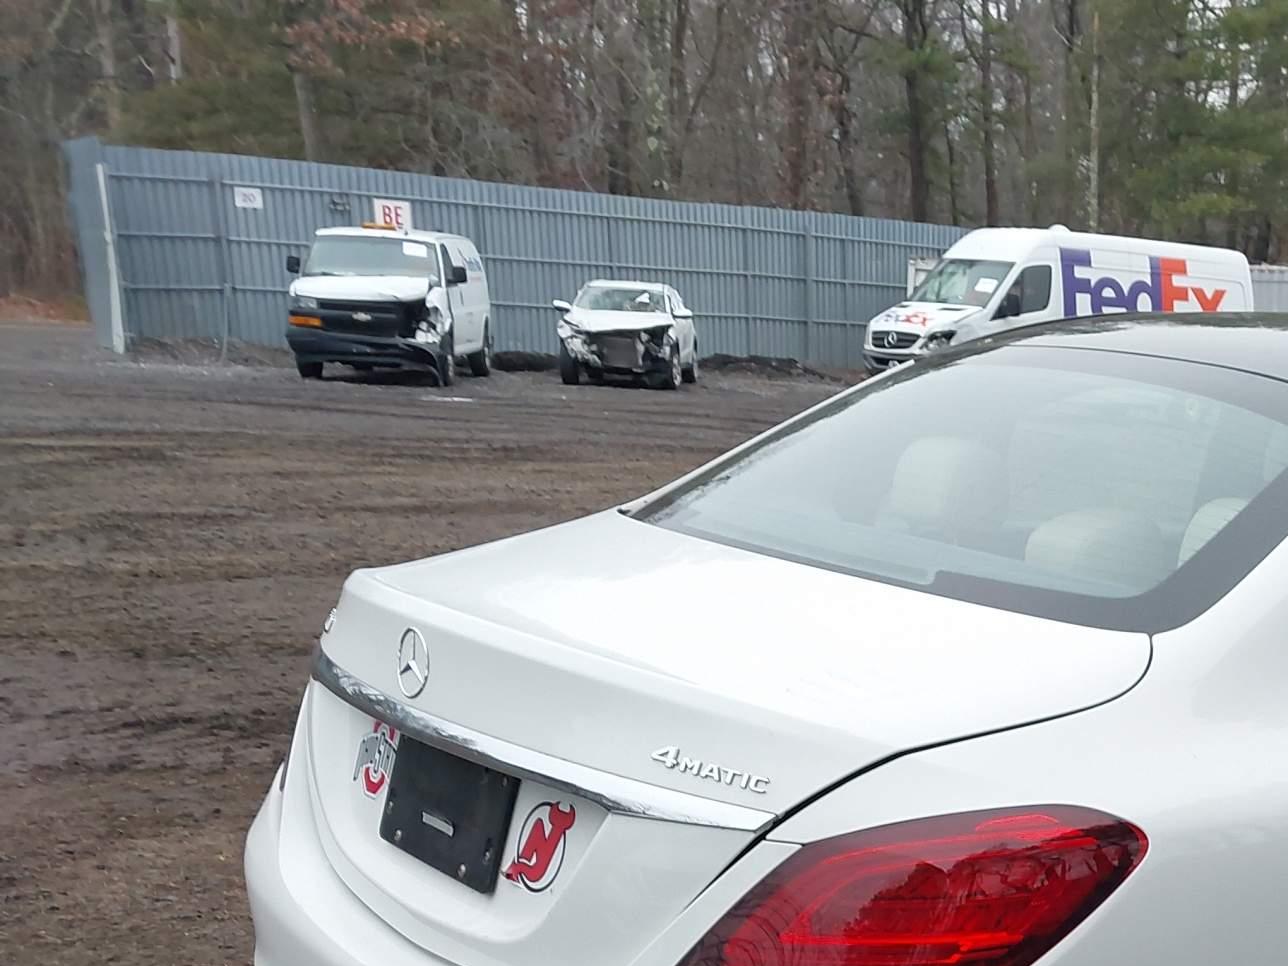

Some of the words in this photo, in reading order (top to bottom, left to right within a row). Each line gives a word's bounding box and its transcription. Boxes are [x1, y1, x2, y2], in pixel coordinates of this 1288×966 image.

[382, 204, 404, 226] BE
[1060, 247, 1227, 318] FedEx
[650, 745, 770, 794] 4MATIC
